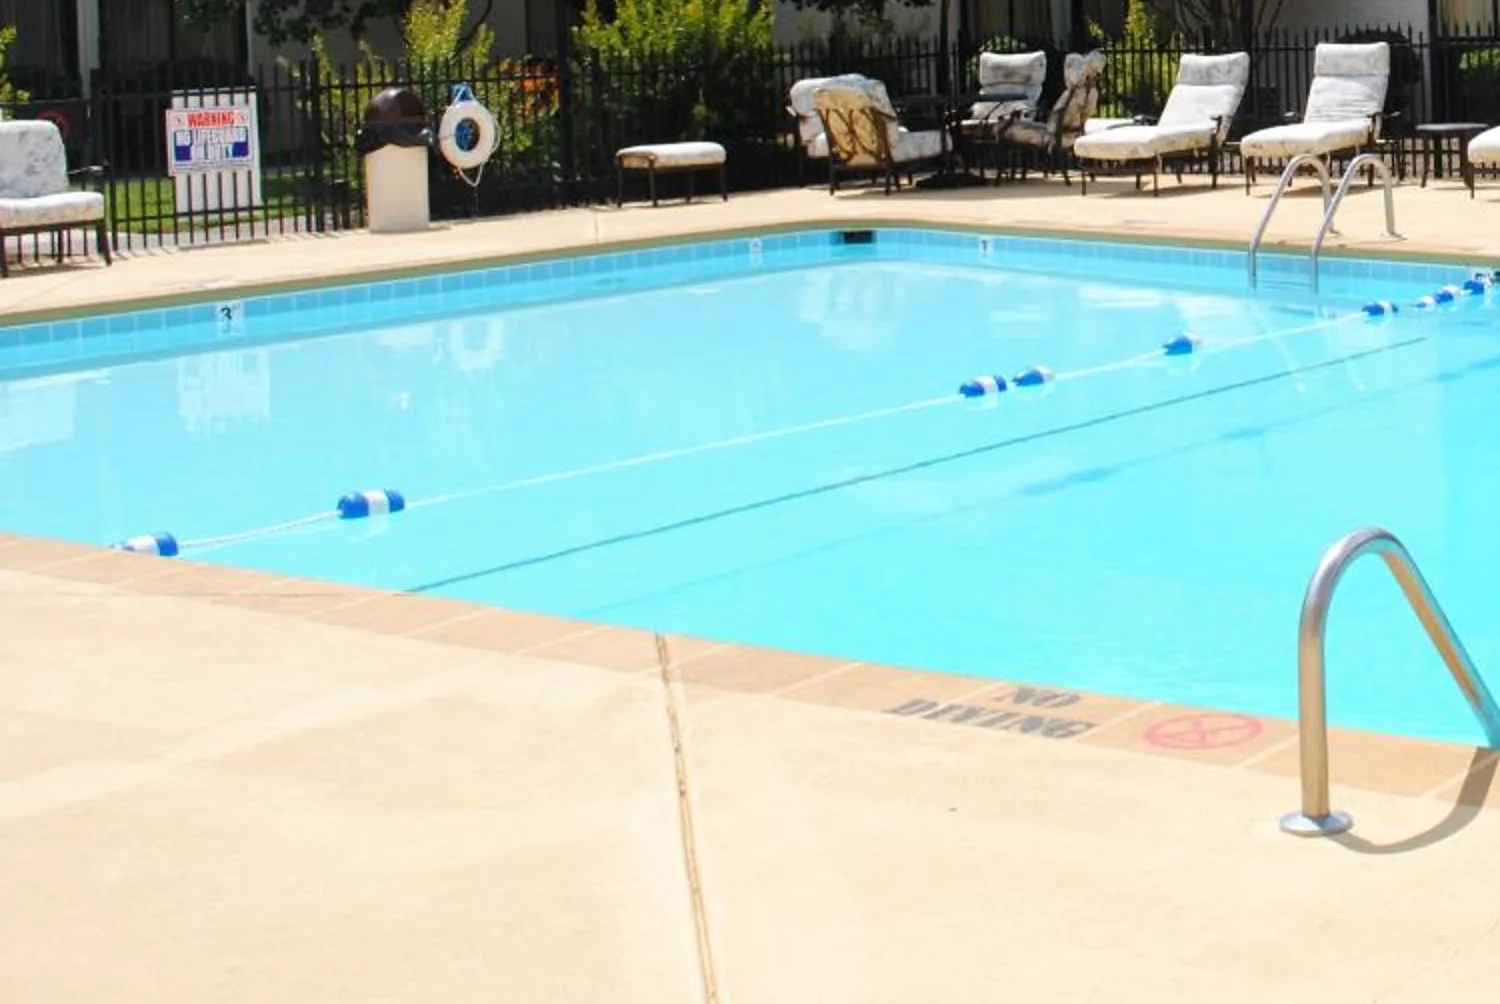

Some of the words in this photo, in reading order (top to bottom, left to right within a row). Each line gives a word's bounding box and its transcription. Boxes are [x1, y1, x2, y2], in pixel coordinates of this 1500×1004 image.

[187, 111, 235, 127] WARNING
[992, 687, 1082, 708] NO
[882, 698, 1097, 738] DIVING
